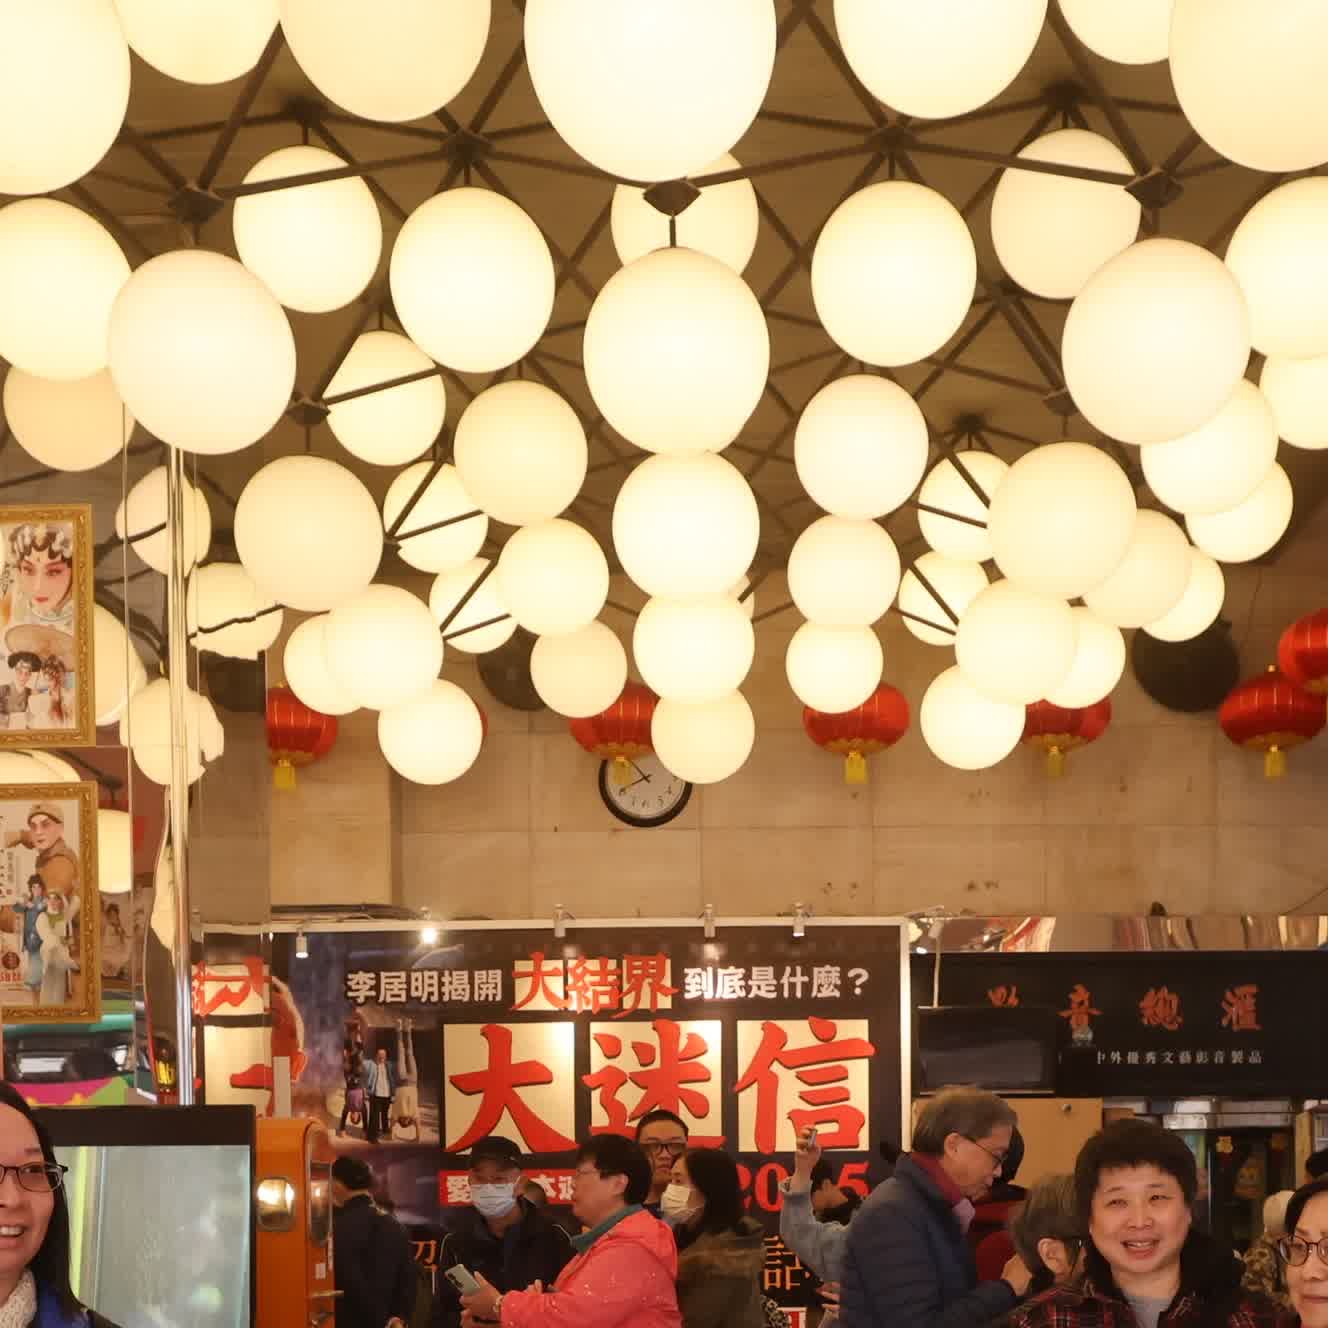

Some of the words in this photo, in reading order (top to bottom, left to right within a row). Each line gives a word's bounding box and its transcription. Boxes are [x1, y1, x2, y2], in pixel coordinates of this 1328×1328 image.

[346, 969, 503, 1004] 李居明揭開
[510, 951, 680, 1018] 大結界
[683, 965, 870, 1001] 到底是什麼？
[443, 1016, 876, 1156] 大迷信
